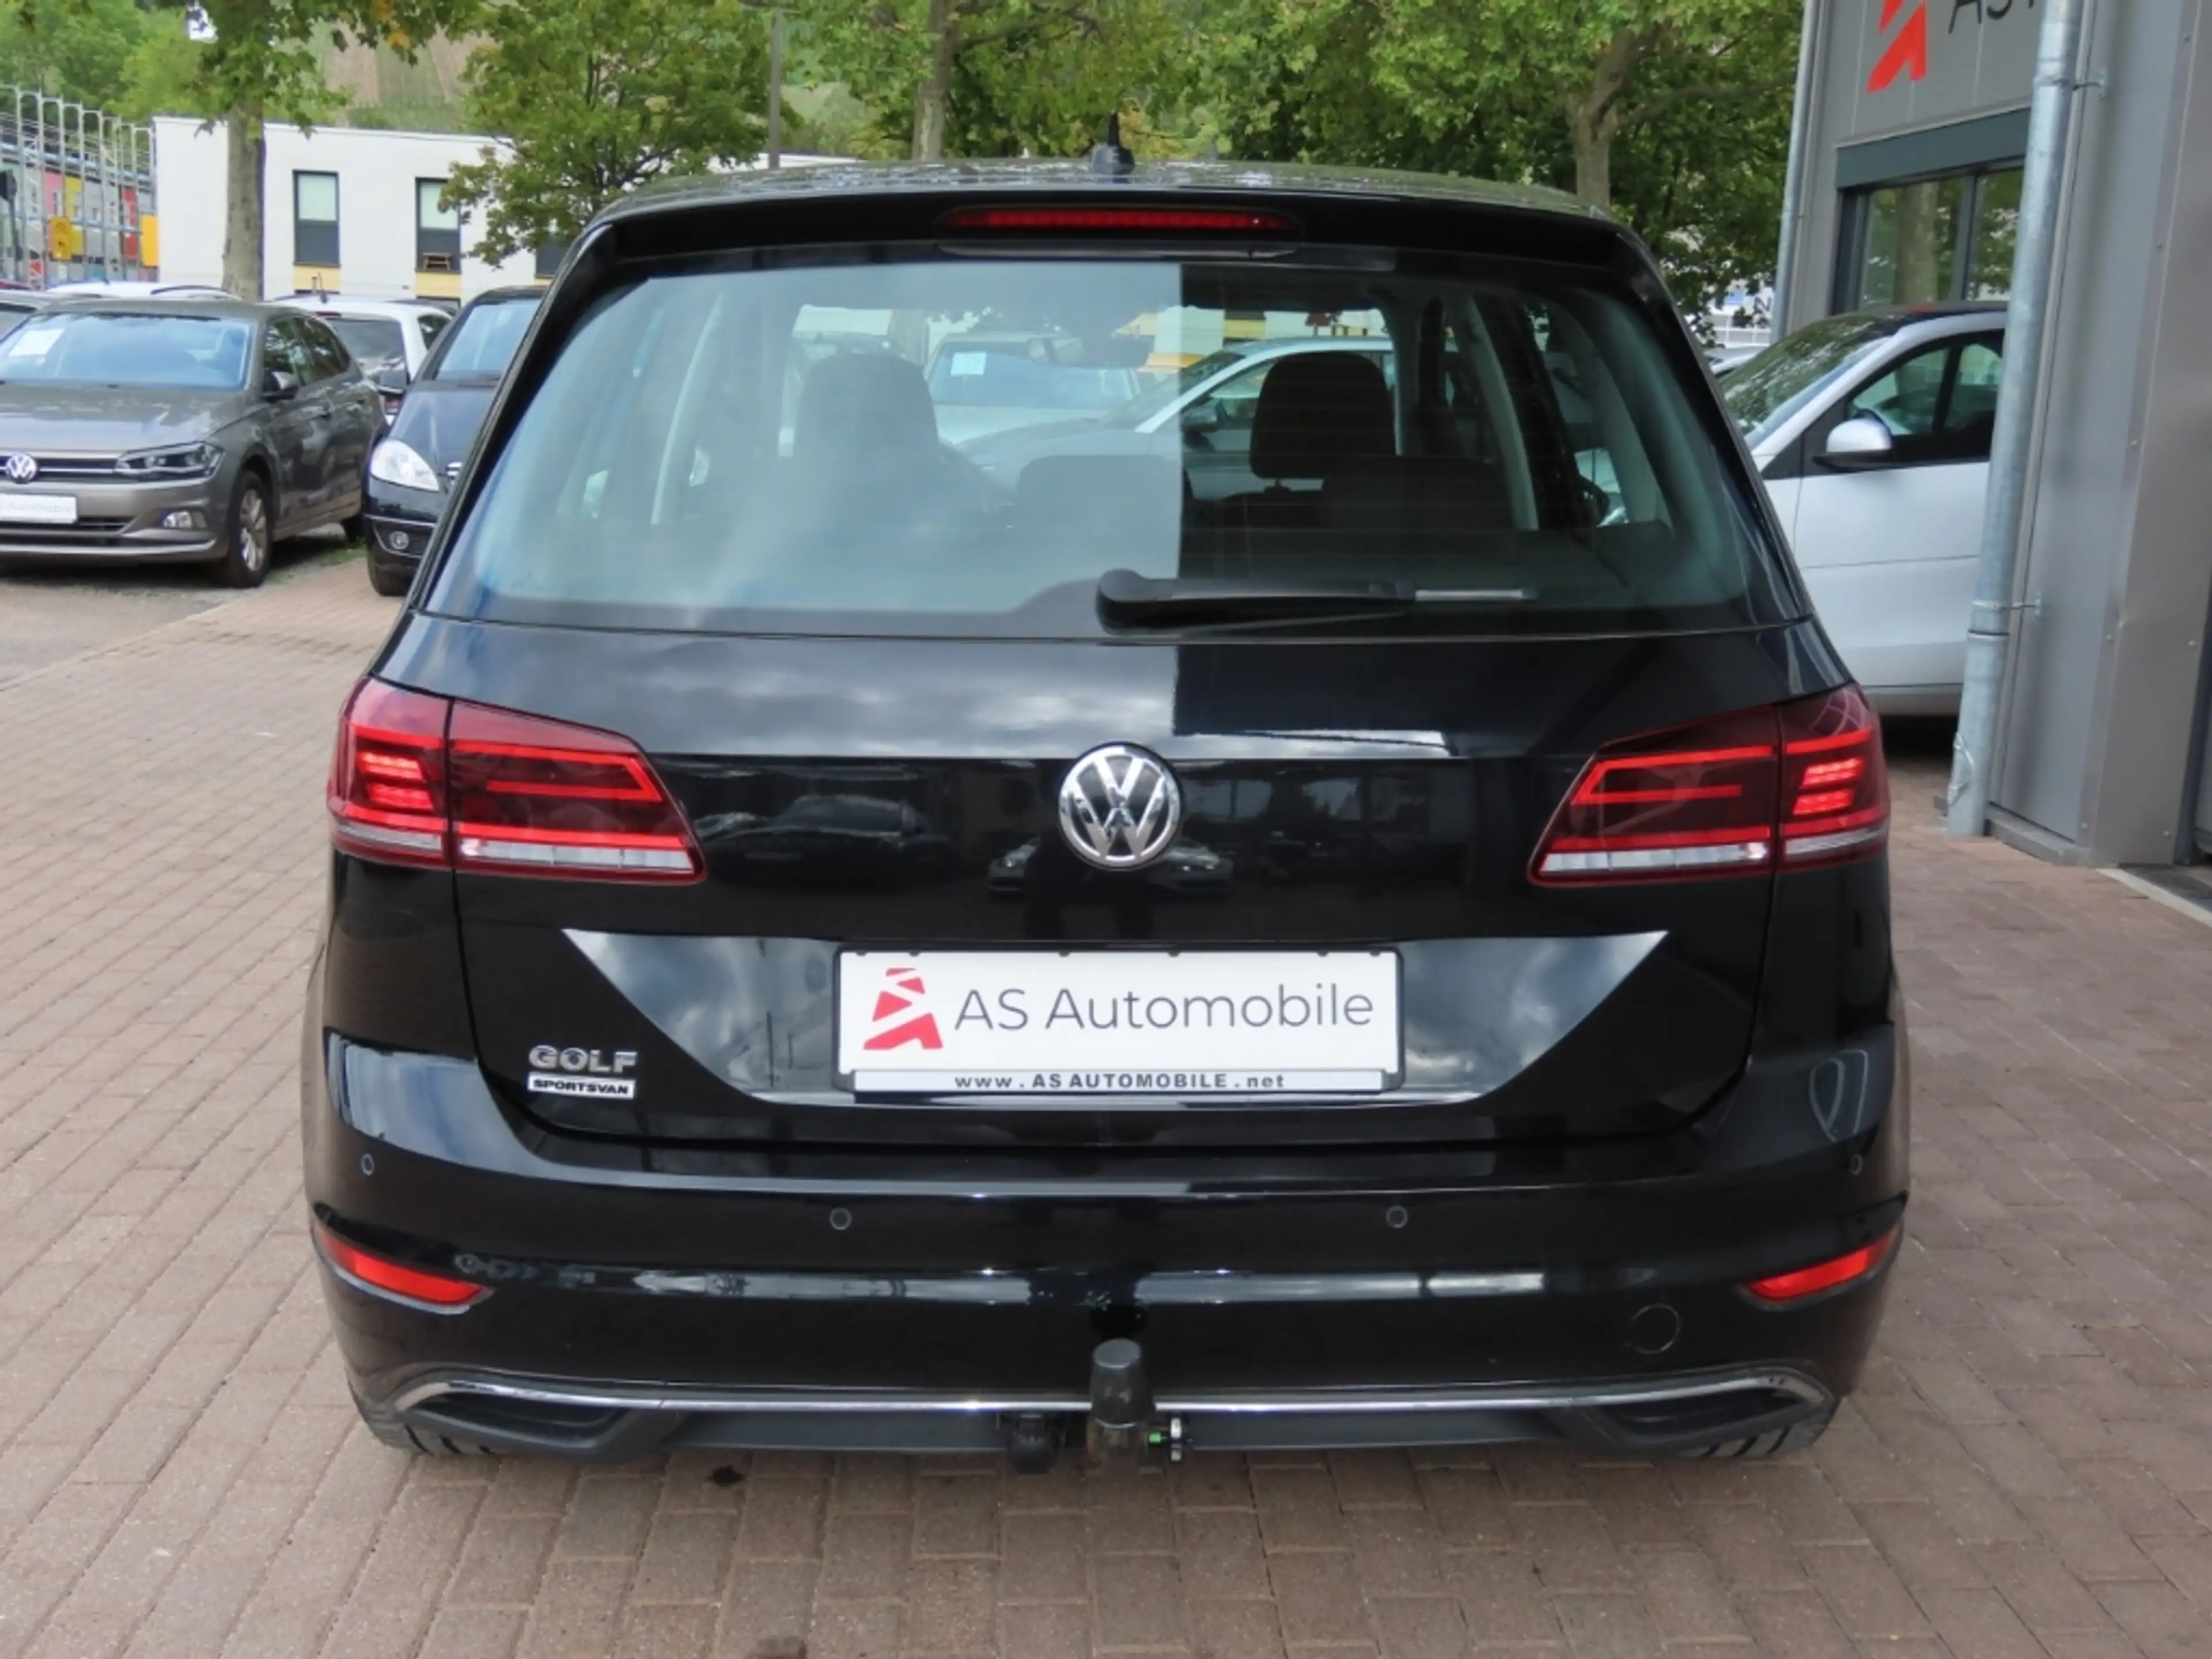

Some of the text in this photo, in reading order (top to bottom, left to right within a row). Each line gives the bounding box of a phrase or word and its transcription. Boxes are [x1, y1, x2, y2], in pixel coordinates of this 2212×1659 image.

[954, 983, 1374, 1030] AS Automobile
[529, 1045, 638, 1073] GOLF
[533, 1079, 628, 1094] SPORTSVAN
